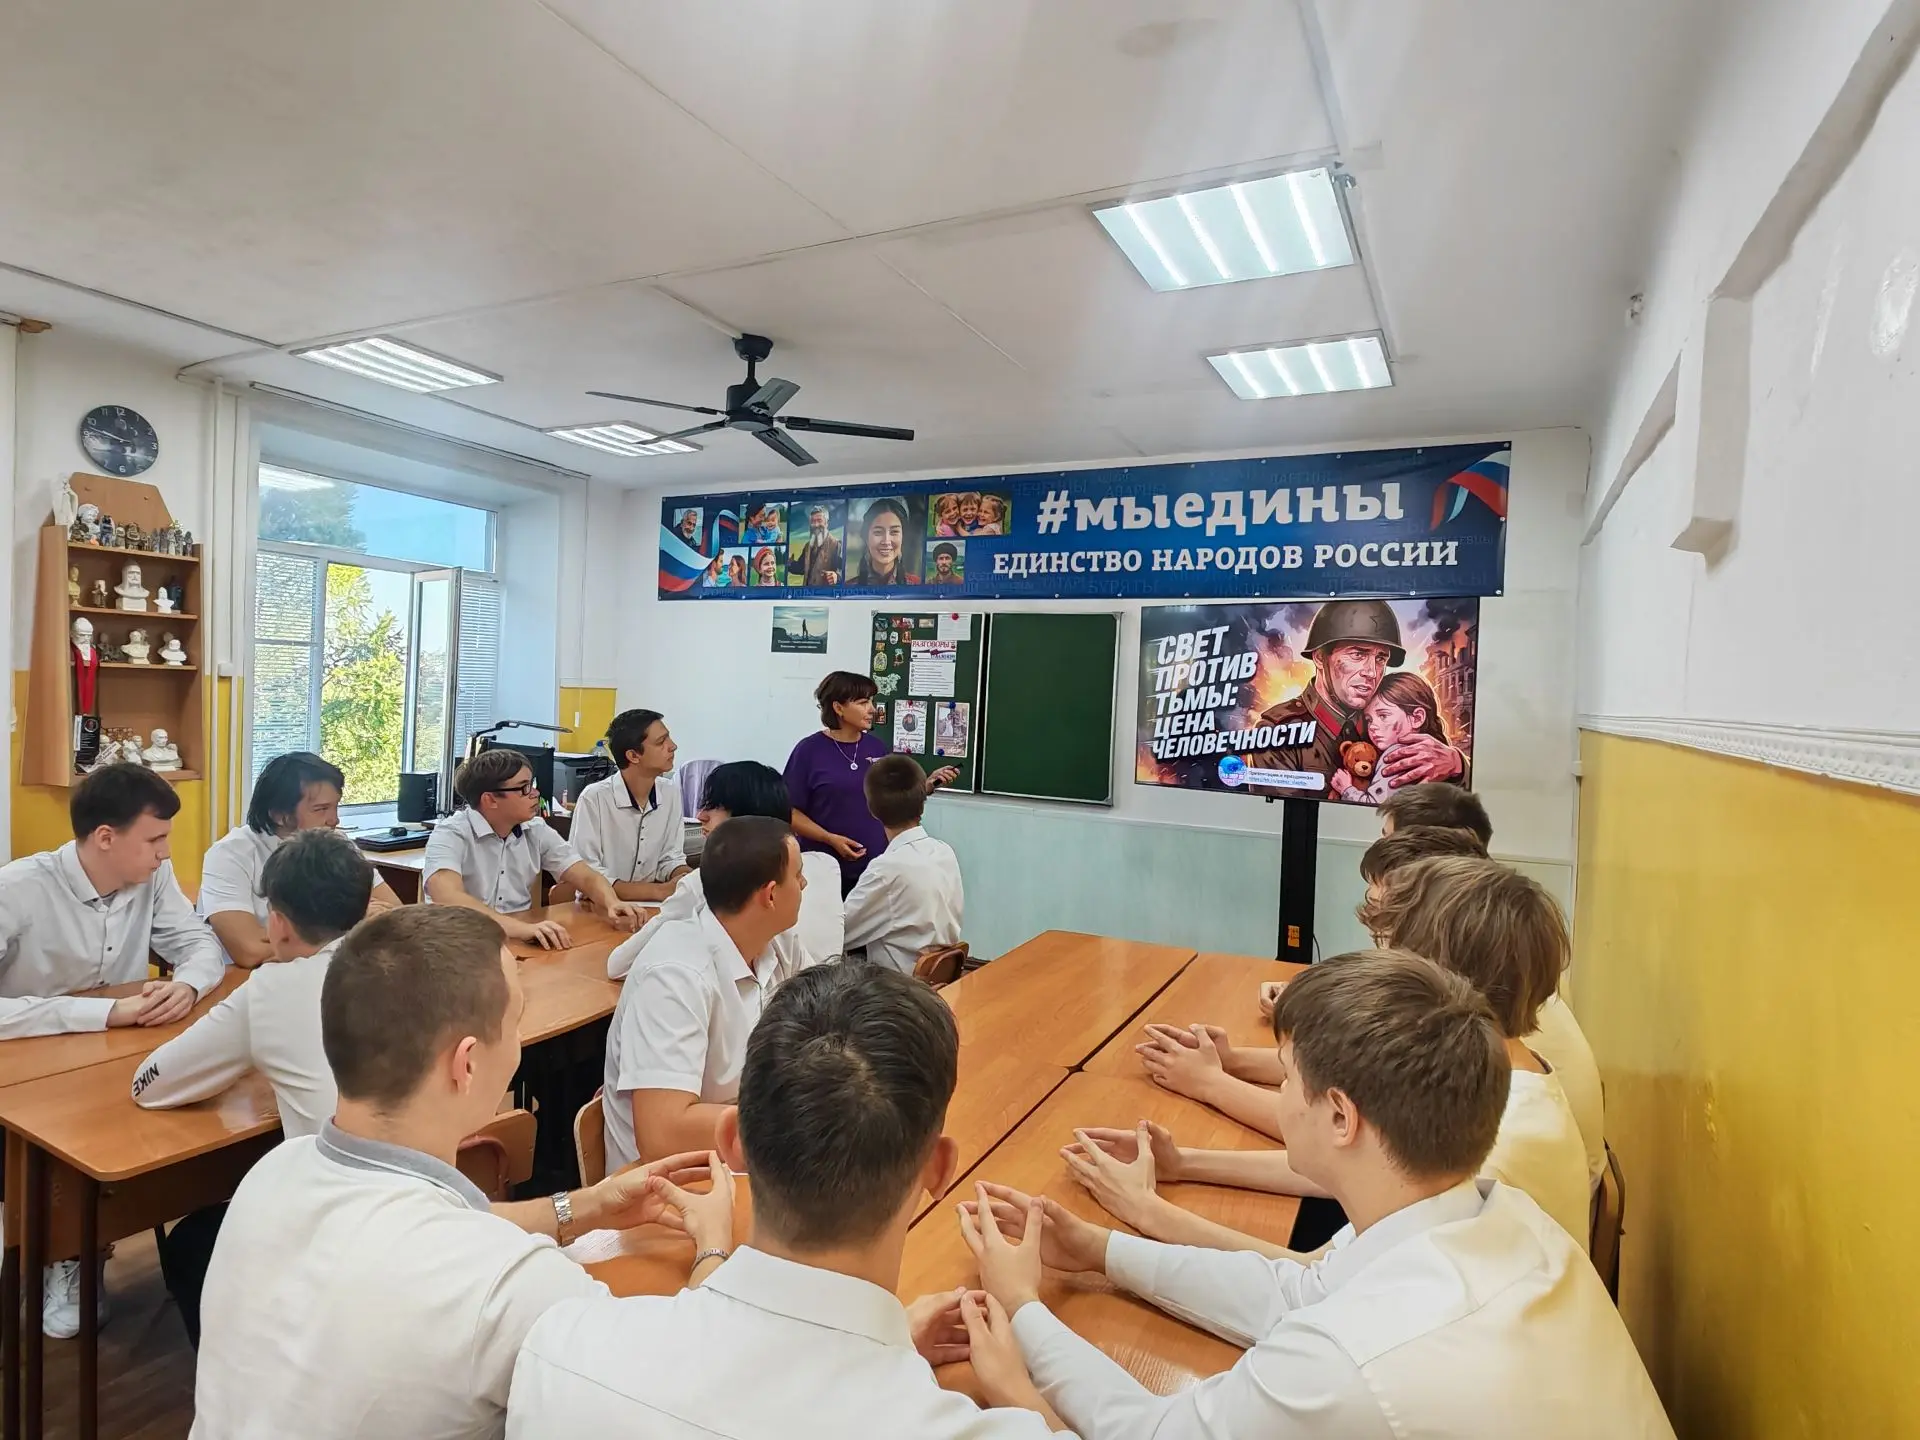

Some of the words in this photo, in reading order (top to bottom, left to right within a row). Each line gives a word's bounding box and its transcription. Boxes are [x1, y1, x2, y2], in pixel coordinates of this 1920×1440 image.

[115, 407, 126, 416] 12
[1036, 482, 1404, 537] #мыедины
[993, 549, 1142, 579] ЕДИНСТВО
[1151, 546, 1303, 575] НАРОДОВ
[1313, 541, 1459, 569] РОССИИ
[1158, 625, 1230, 665] СВЕТ
[1155, 651, 1258, 692] ПРОТИВ
[1155, 683, 1239, 715] ТЬМЫ:
[1152, 720, 1317, 760] ЧЕЛОВЕЧНОСТИ
[1153, 710, 1216, 739] ЦЕНА
[133, 1062, 160, 1097] NIKE
